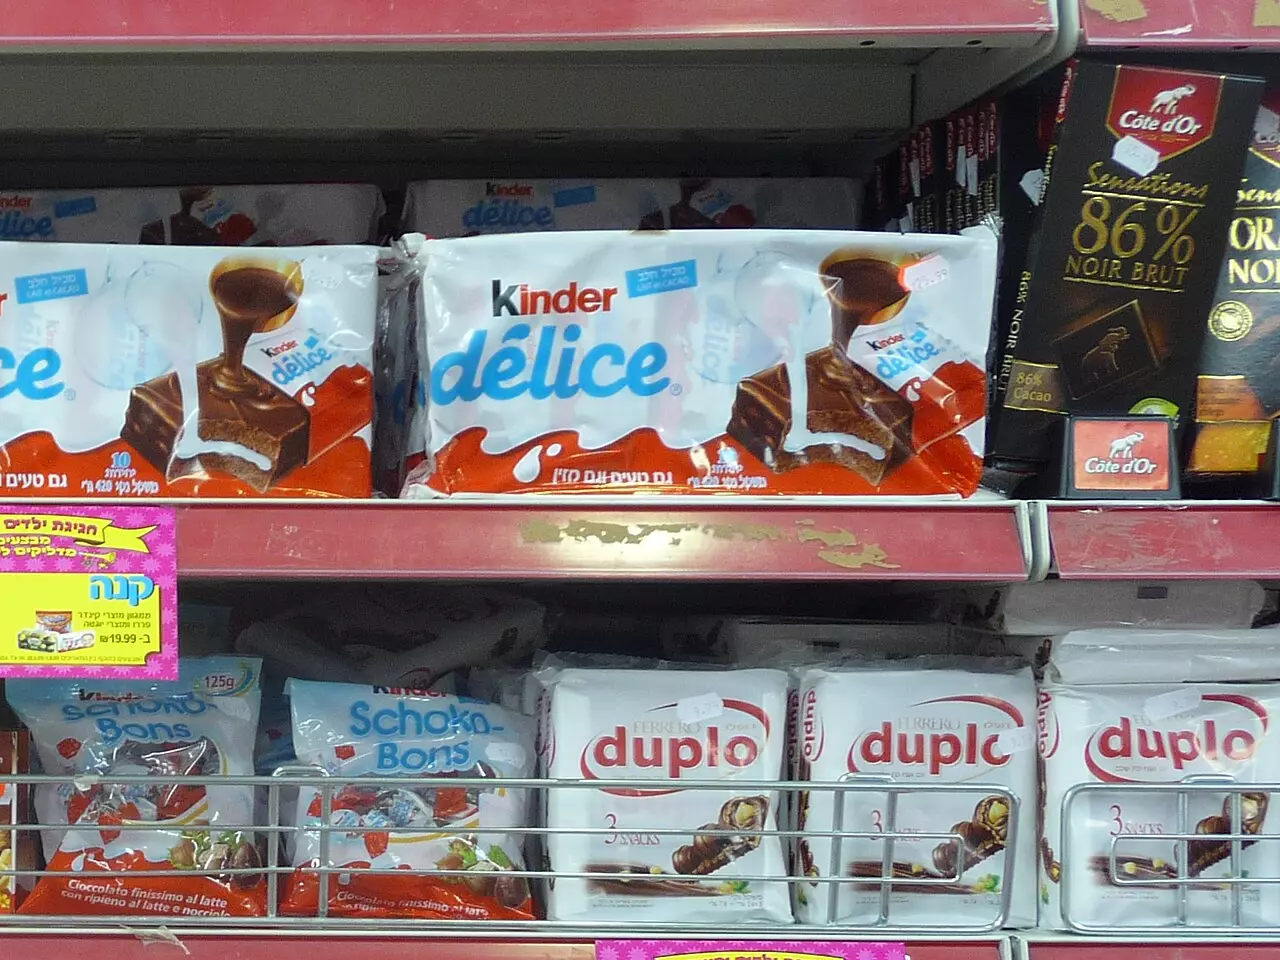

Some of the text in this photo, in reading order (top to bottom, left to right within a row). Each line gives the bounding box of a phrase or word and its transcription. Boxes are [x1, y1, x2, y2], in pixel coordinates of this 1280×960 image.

[1120, 111, 1201, 134] Côte d'Or
[1072, 197, 1197, 264] 86%
[1065, 255, 1189, 286] NOIR BRUT
[492, 279, 617, 317] Kinder
[1007, 310, 1023, 348] NOIR
[433, 325, 670, 403] délice
[1014, 387, 1051, 401] Cacao
[110, 452, 131, 468] 10
[1085, 456, 1157, 475] Côte d'Or
[7, 473, 43, 487] טעים
[48, 474, 67, 487] גם
[90, 574, 154, 606] קנה
[205, 676, 234, 689] 125g
[97, 719, 191, 742] Bons
[633, 720, 702, 734] FERRERO
[377, 740, 470, 771] Bons
[593, 725, 758, 779] duplo
[1098, 717, 1256, 770] duplo
[69, 879, 227, 908] Cioccolato finissimo al latte
